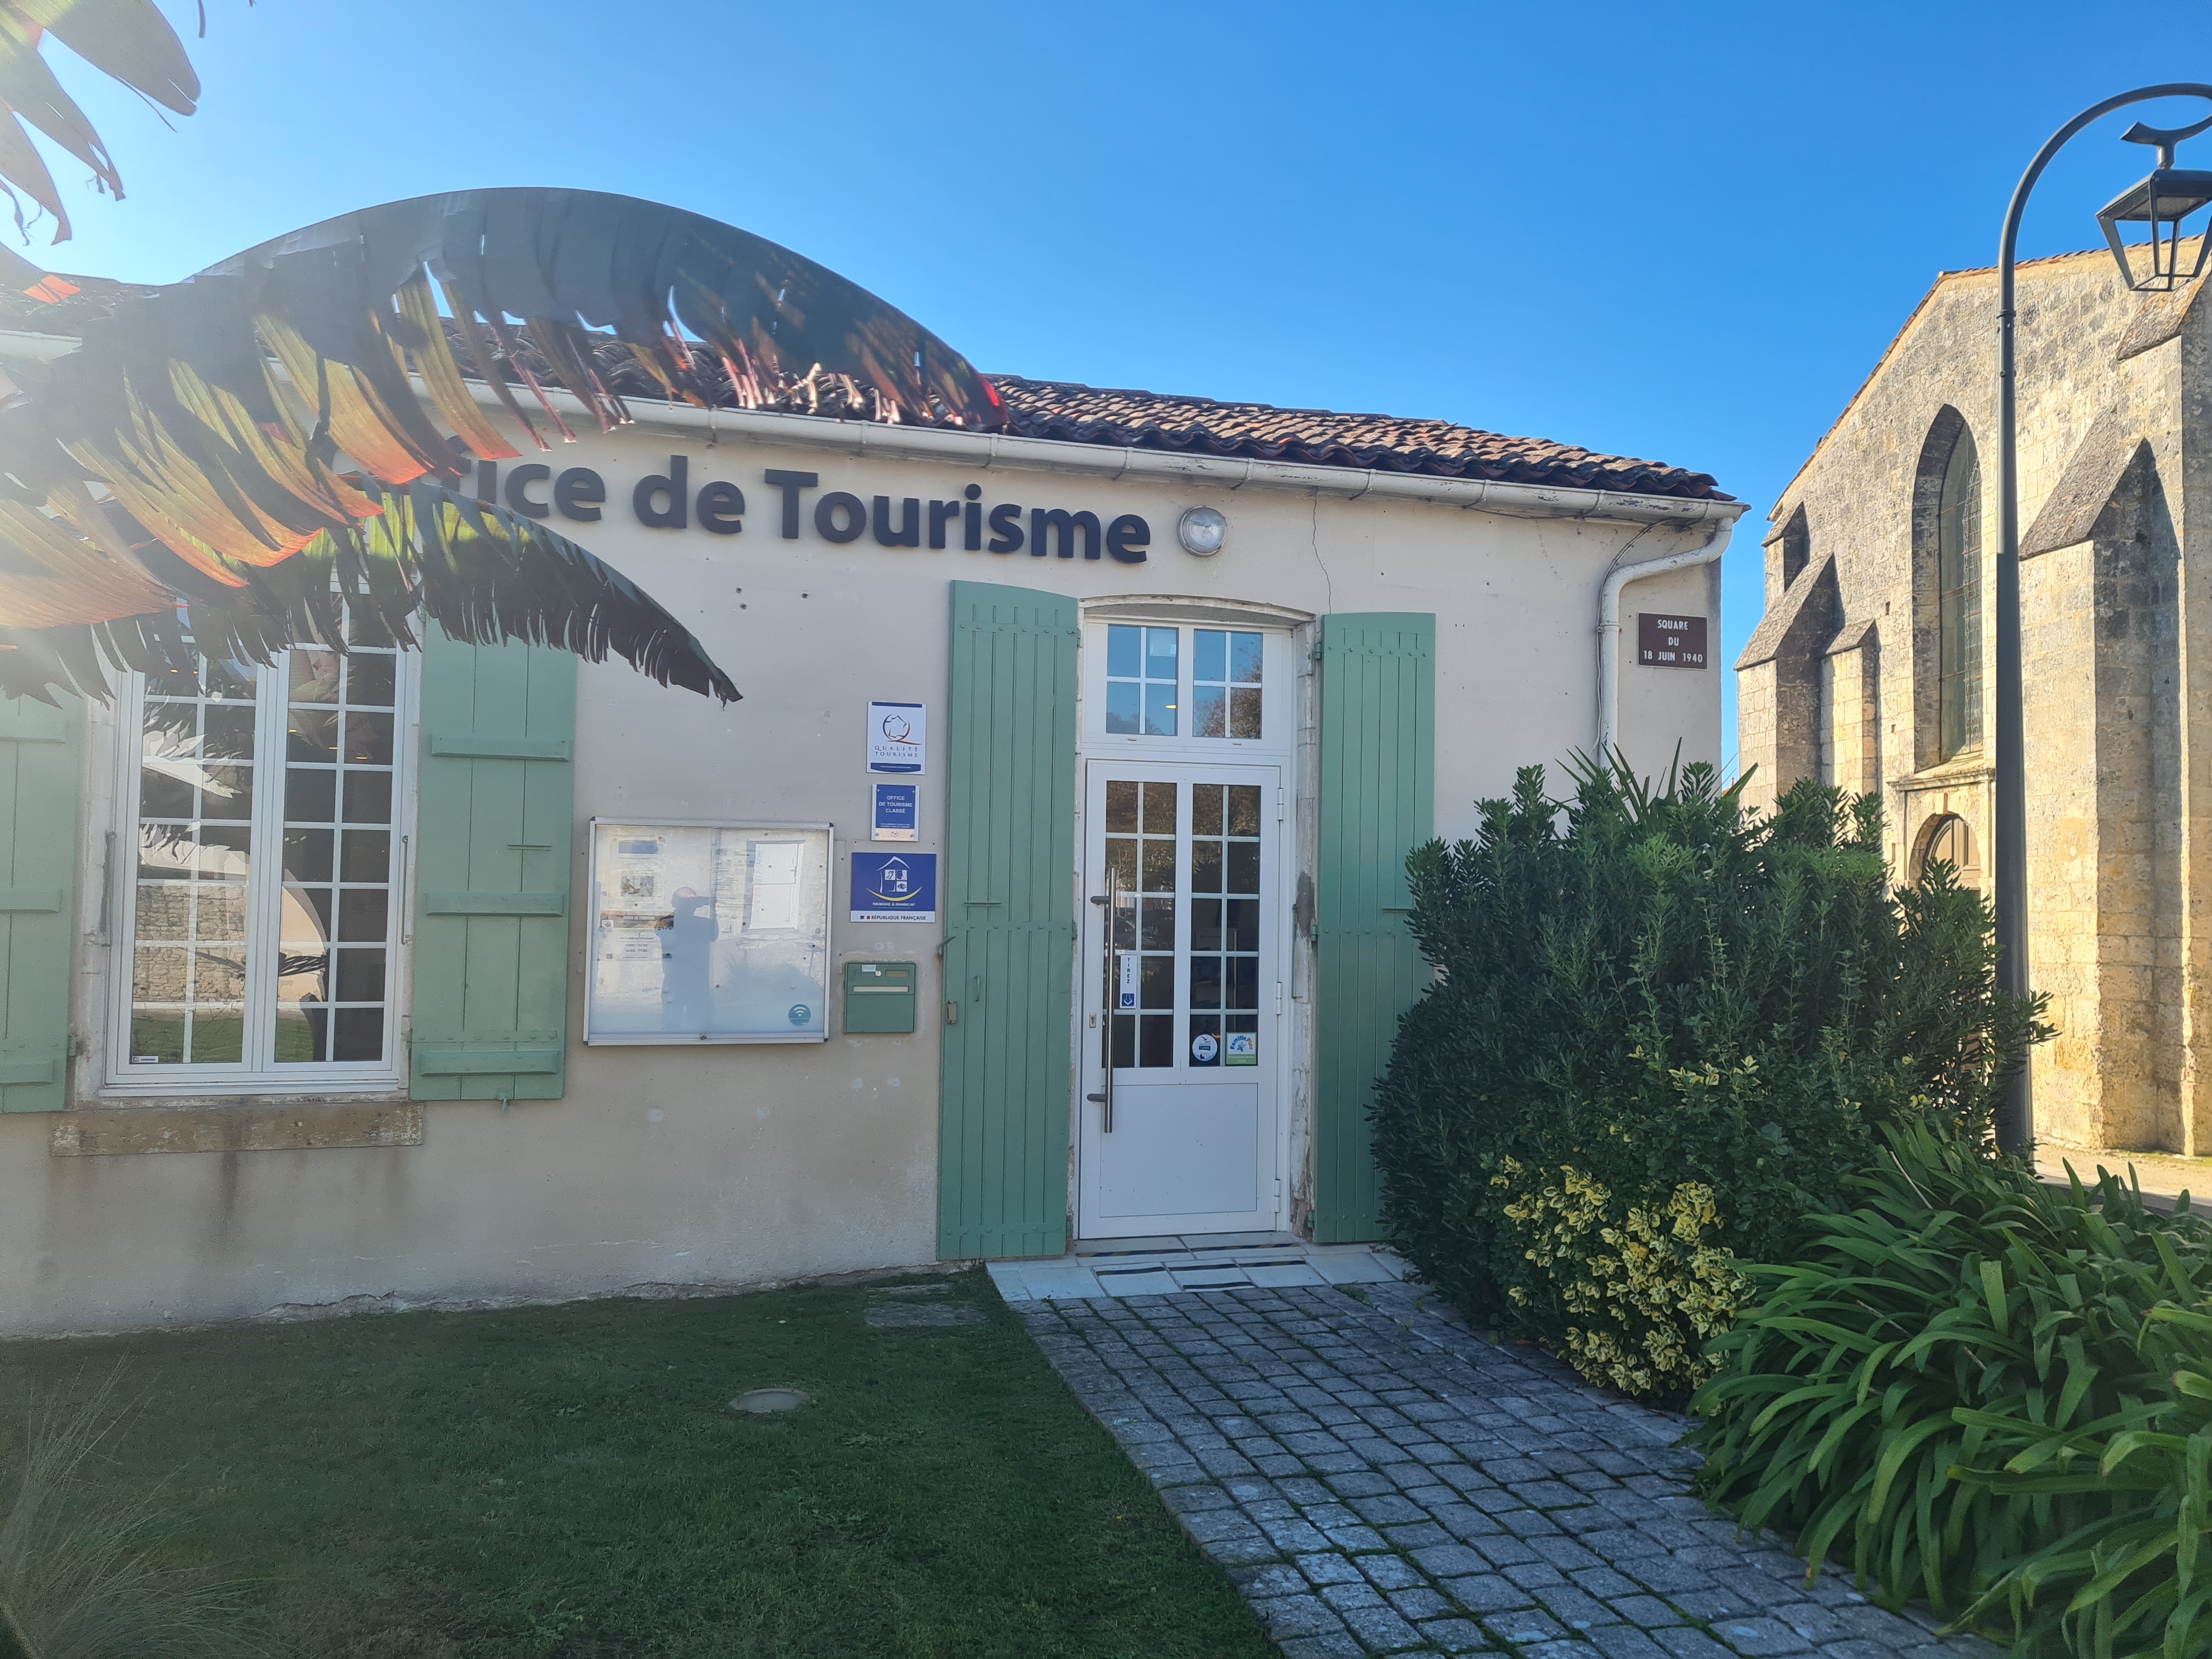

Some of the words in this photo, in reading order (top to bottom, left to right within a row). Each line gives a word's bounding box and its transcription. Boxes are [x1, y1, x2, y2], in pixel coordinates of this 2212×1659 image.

[632, 454, 745, 534] de
[764, 468, 1152, 564] Tourisme
[1657, 619, 1689, 630] SQUARE
[1668, 636, 1679, 646] DU
[1643, 650, 1653, 660] 18
[1657, 651, 1675, 661] JUIN
[1682, 652, 1703, 663] 1940
